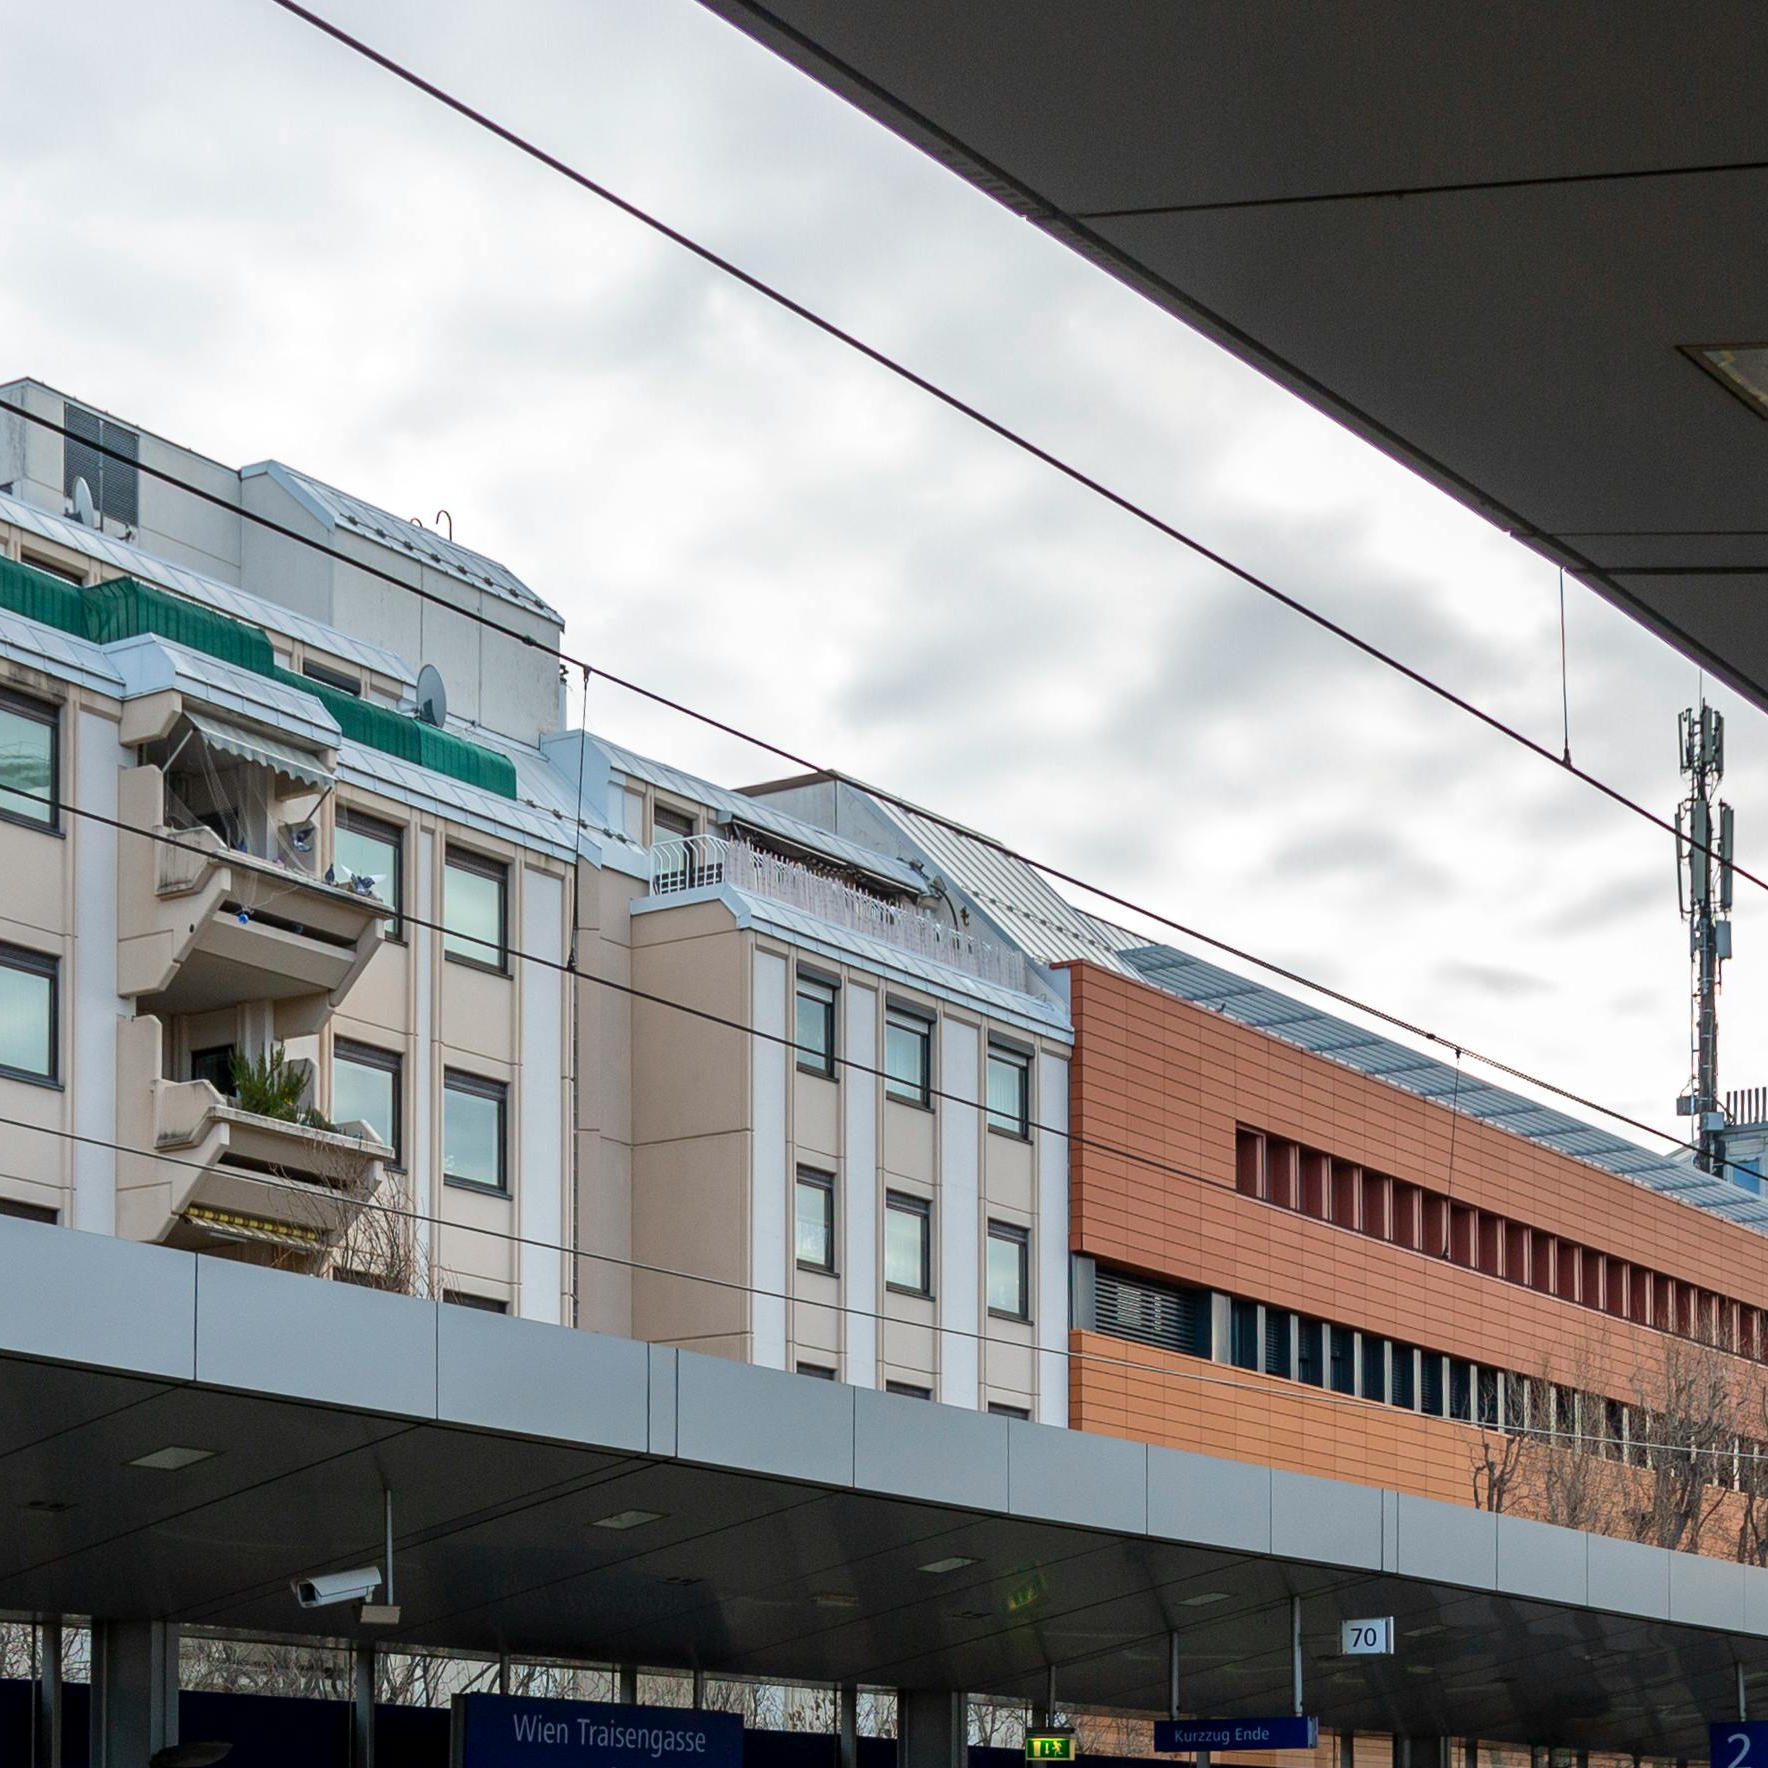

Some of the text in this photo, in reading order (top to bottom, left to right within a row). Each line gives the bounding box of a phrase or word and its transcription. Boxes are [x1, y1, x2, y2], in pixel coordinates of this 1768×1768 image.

[1350, 1627, 1377, 1649] 70
[512, 1713, 707, 1759] Wien Traisengasse
[1173, 1725, 1270, 1746] Kurzzug Ende
